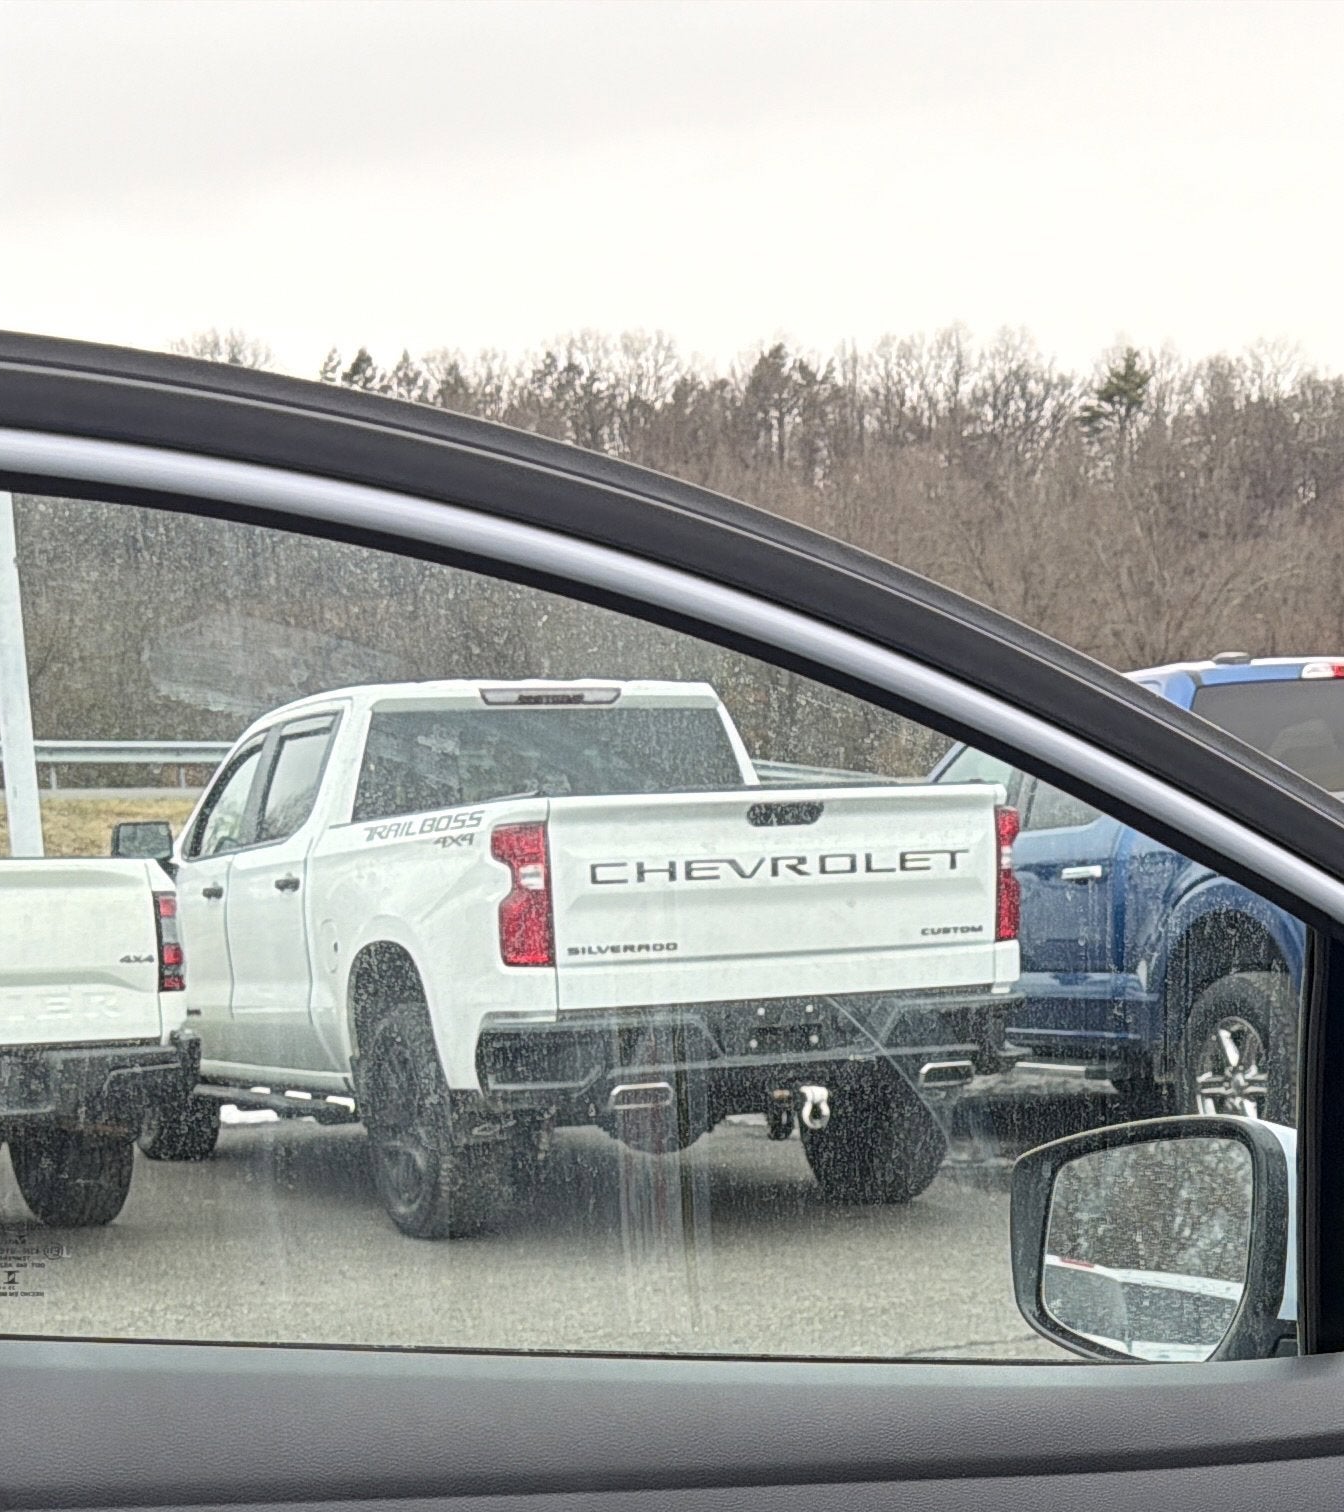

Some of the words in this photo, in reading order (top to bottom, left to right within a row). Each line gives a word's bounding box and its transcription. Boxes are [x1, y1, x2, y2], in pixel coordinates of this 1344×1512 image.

[364, 821, 417, 842] TRAIL
[419, 810, 485, 835] BOSS
[590, 849, 970, 885] CHEVROLET
[920, 924, 984, 936] CUSTOM
[567, 942, 679, 956] SILVERADO
